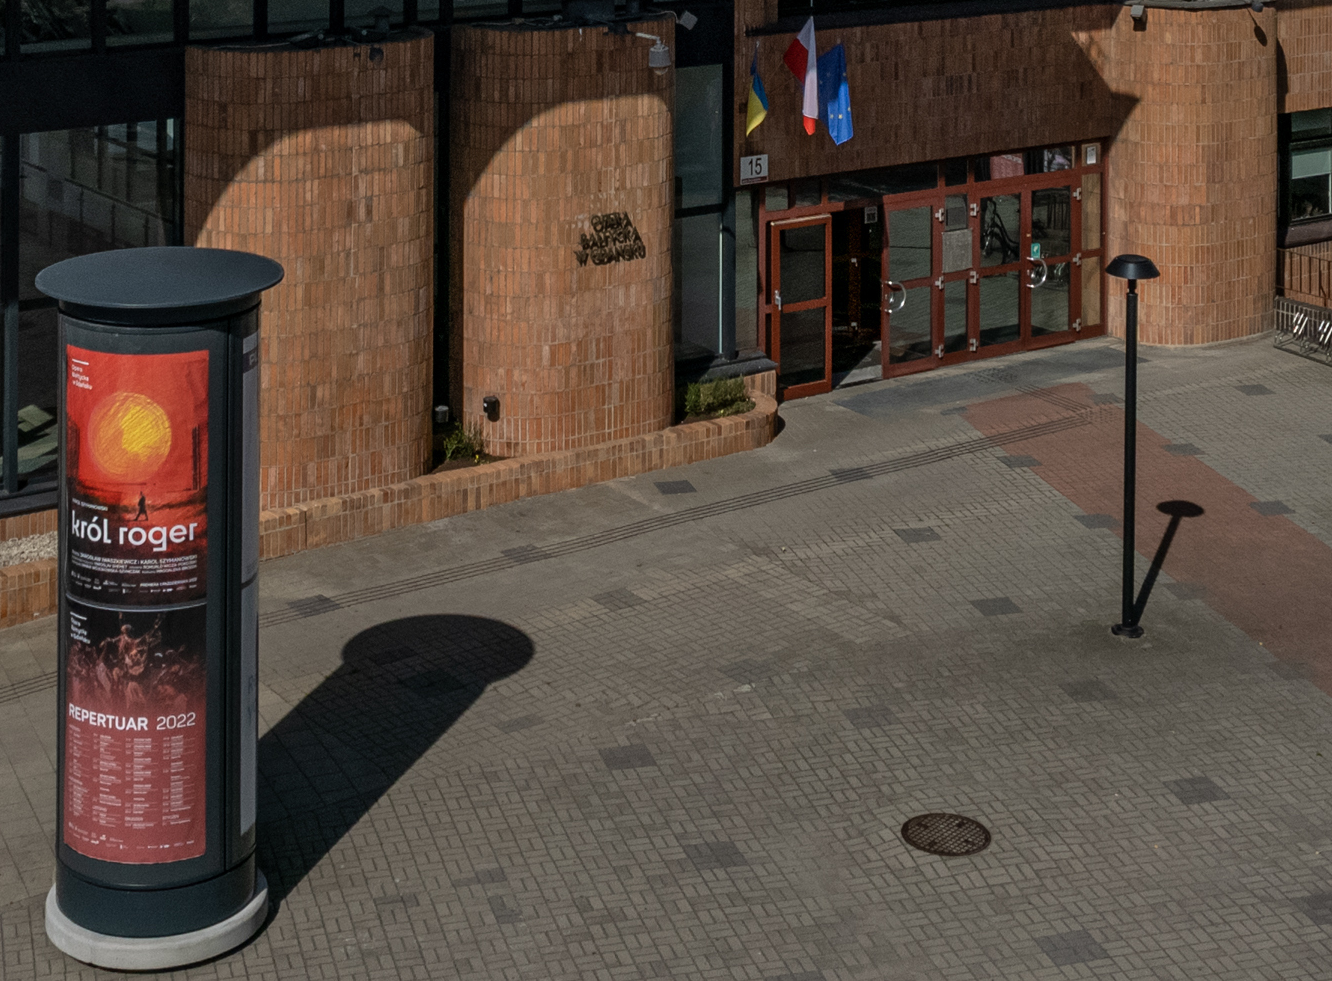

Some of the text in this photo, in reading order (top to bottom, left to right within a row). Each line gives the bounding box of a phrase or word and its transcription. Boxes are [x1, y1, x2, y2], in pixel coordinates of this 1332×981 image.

[748, 158, 762, 176] 15
[71, 509, 198, 552] król roger
[68, 703, 196, 731] REPERTUAR 2022
